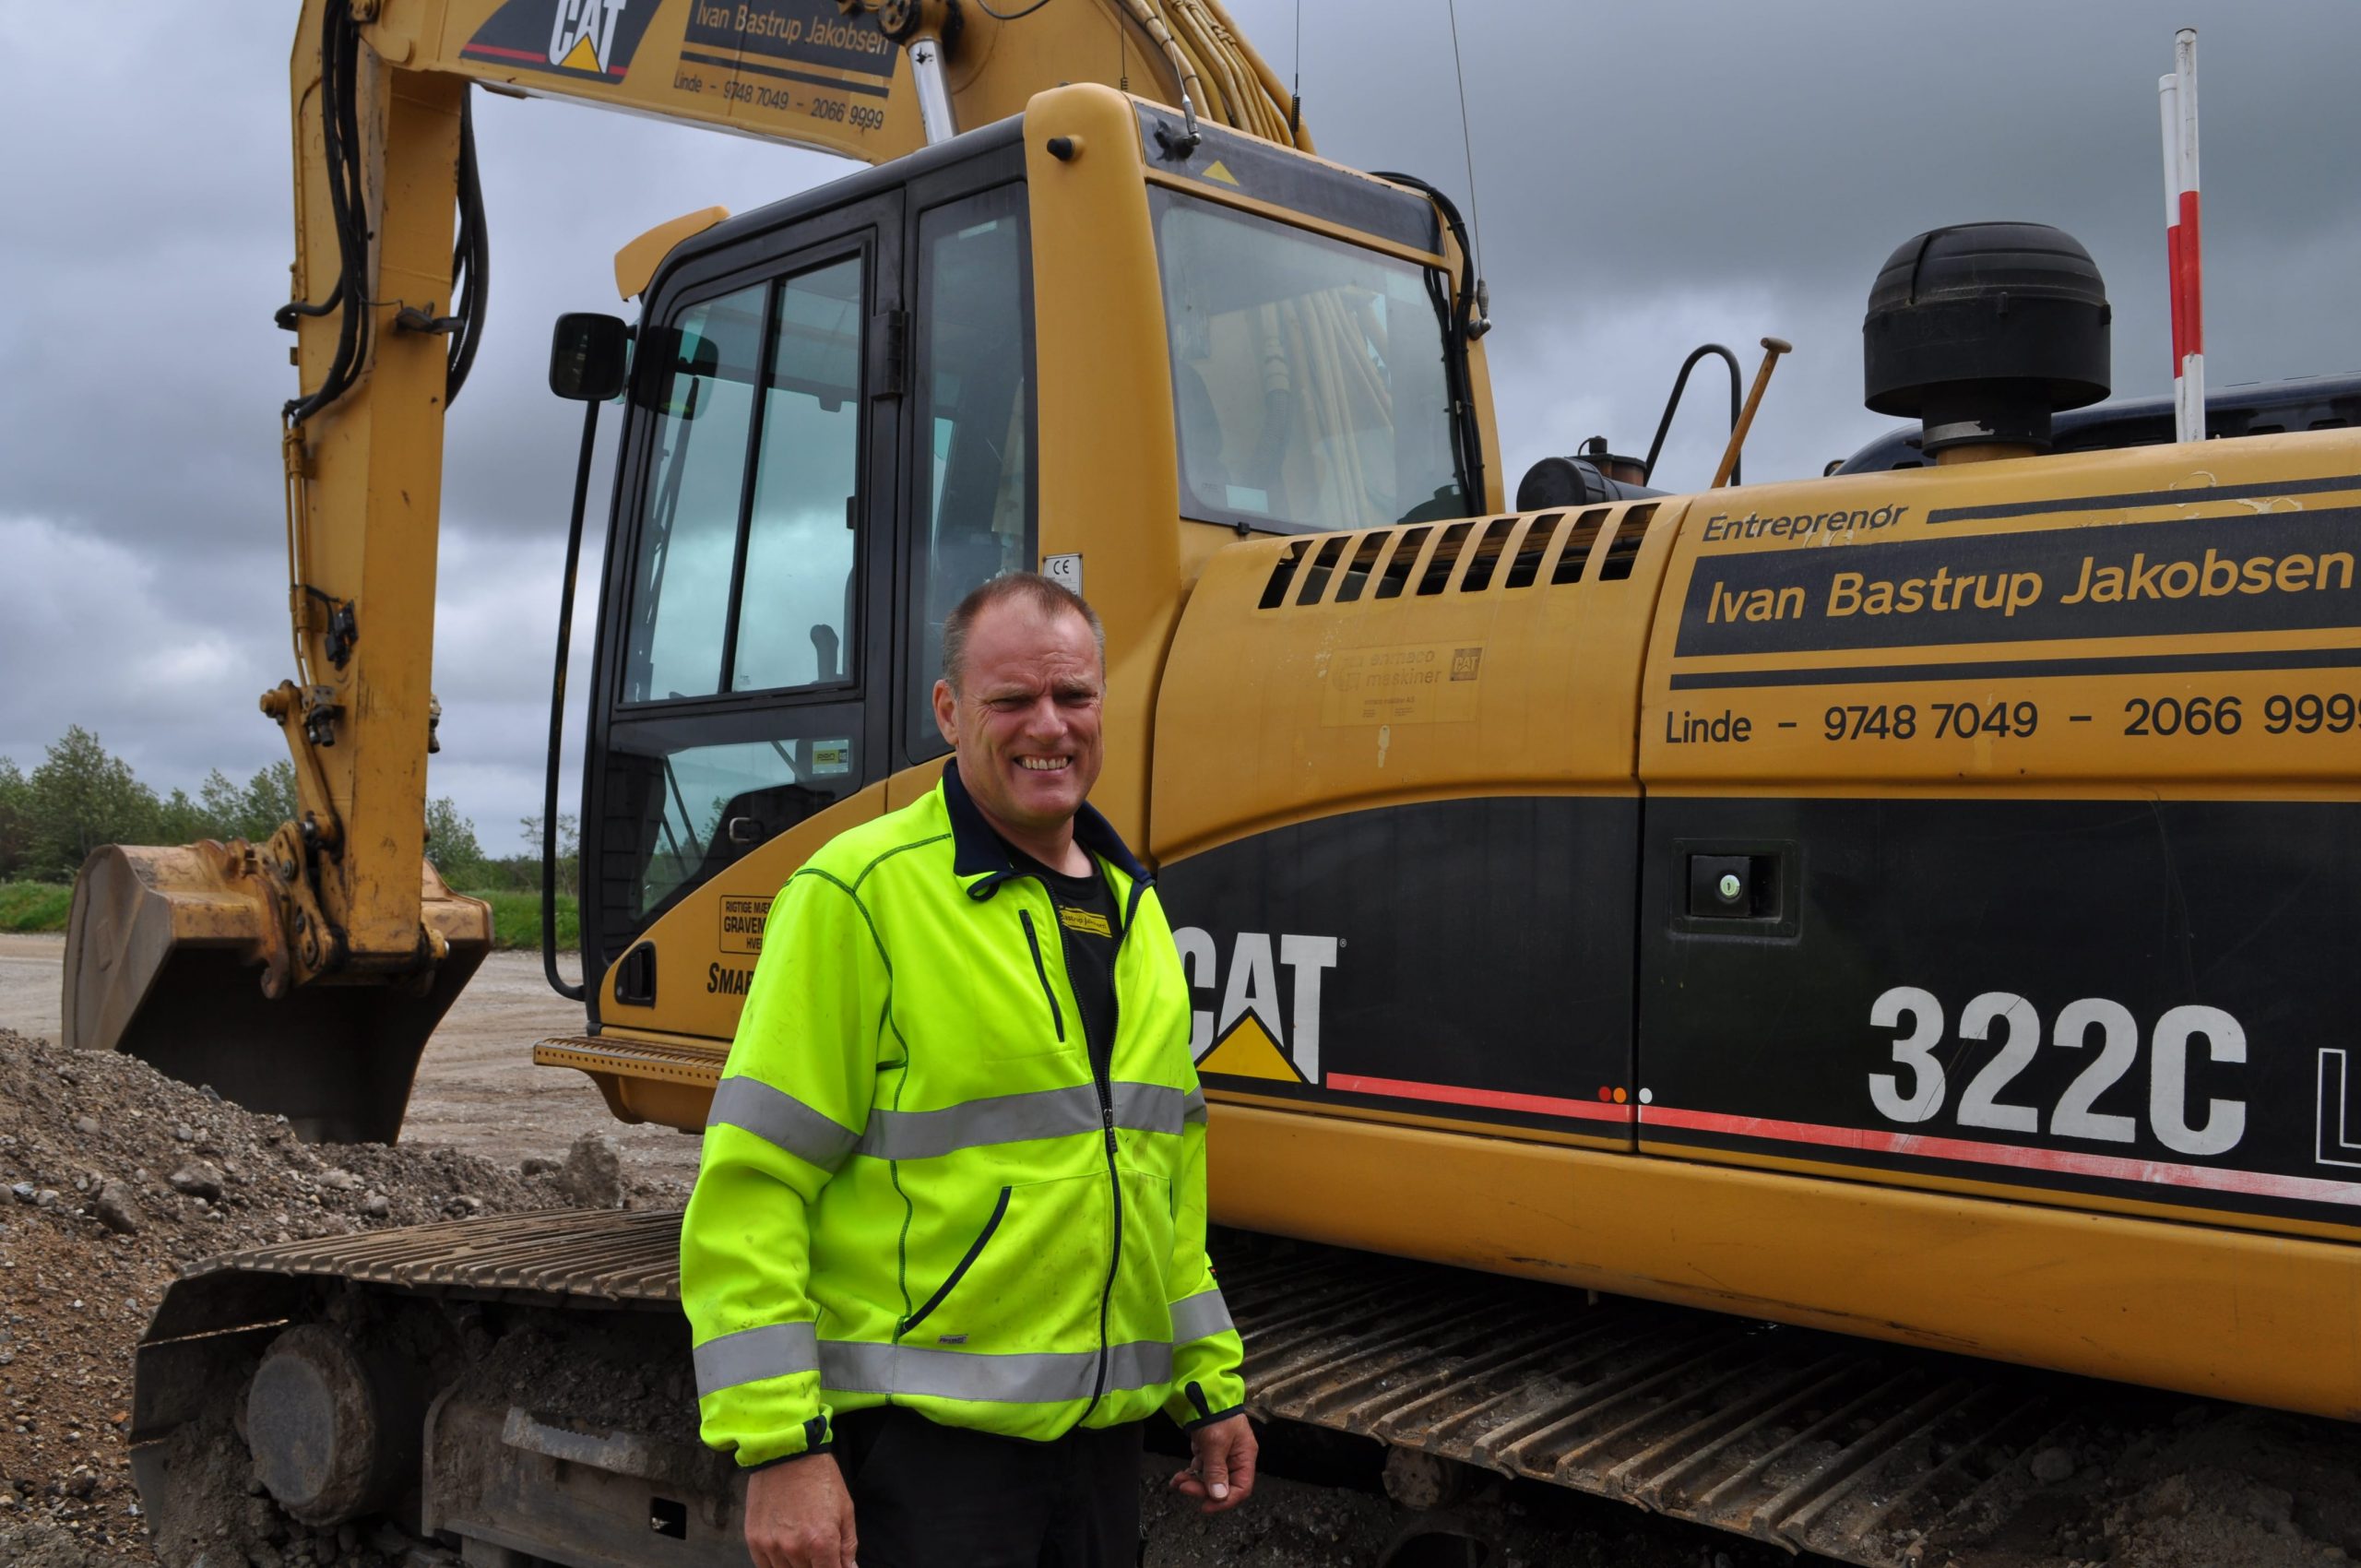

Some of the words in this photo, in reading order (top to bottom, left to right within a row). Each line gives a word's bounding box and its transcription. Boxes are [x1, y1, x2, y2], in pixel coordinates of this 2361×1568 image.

[549, 0, 626, 74] CAT
[696, 4, 730, 30] Ivan
[734, 5, 802, 44] Bastrup
[805, 16, 889, 55] Jakobsen
[673, 69, 703, 93] Linde
[723, 80, 753, 103] 9748
[756, 87, 789, 110] 7049
[811, 98, 846, 122] 2066
[848, 105, 884, 130] 9999
[1702, 504, 1908, 542] Entreprenør
[1706, 580, 1806, 624] Ivan
[1827, 566, 2043, 617] Bastrup
[2060, 548, 2355, 605] Jakobsen
[1366, 668, 1442, 687] maskiner
[1665, 710, 1751, 743] Linde
[1823, 704, 1916, 741] 9748
[1931, 701, 2039, 739] 7049
[2124, 696, 2242, 737] 2066
[2264, 694, 2361, 734] 999
[726, 901, 752, 913] RIGTIGE
[1869, 986, 2247, 1155] 322C
